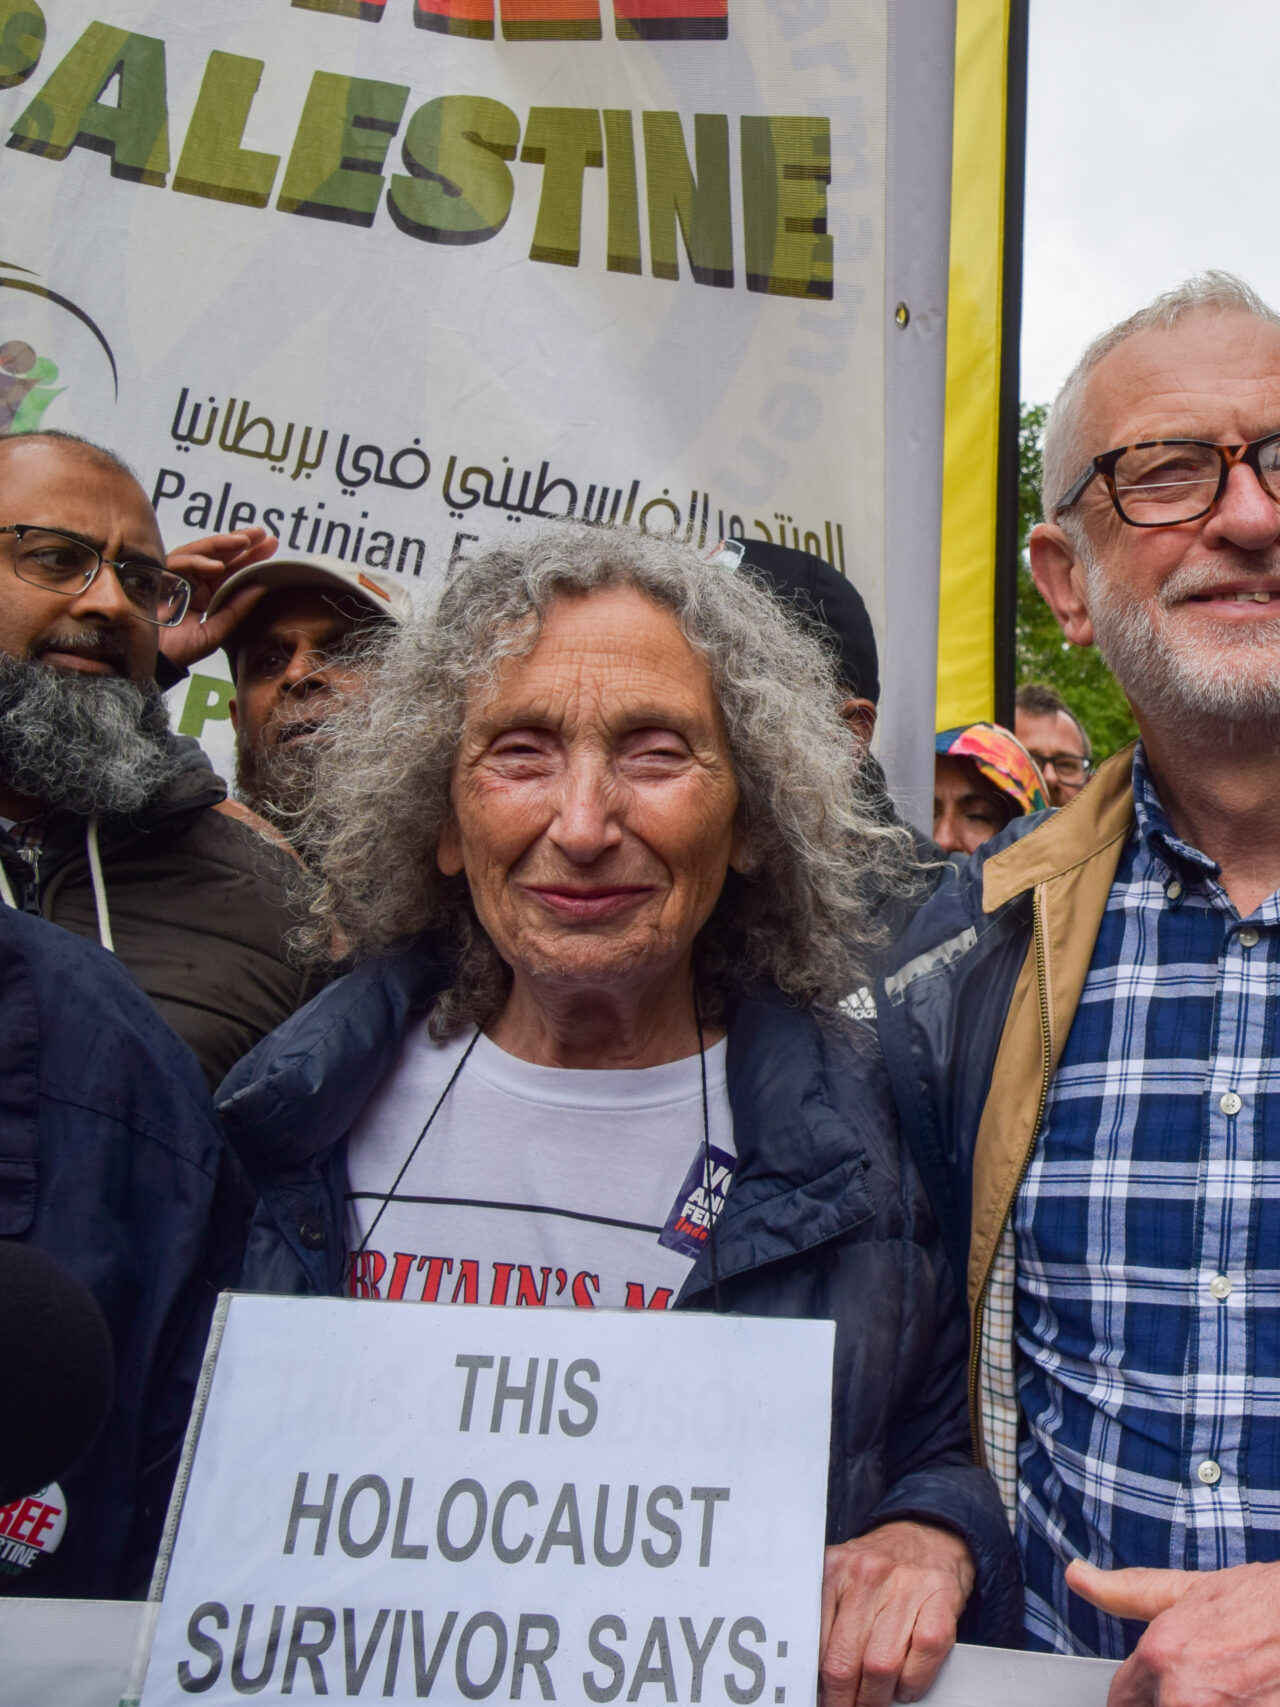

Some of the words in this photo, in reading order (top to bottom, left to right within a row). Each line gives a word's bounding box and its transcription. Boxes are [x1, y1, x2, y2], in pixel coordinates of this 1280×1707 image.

[171, 387, 329, 481] بريطانيا
[335, 437, 431, 497] في
[151, 467, 426, 576] Palestinian
[454, 1354, 600, 1437] THIS
[283, 1471, 730, 1568] HOLOCAUST
[178, 1601, 561, 1700] SURVIVOR
[582, 1615, 789, 1705] SAYS:
